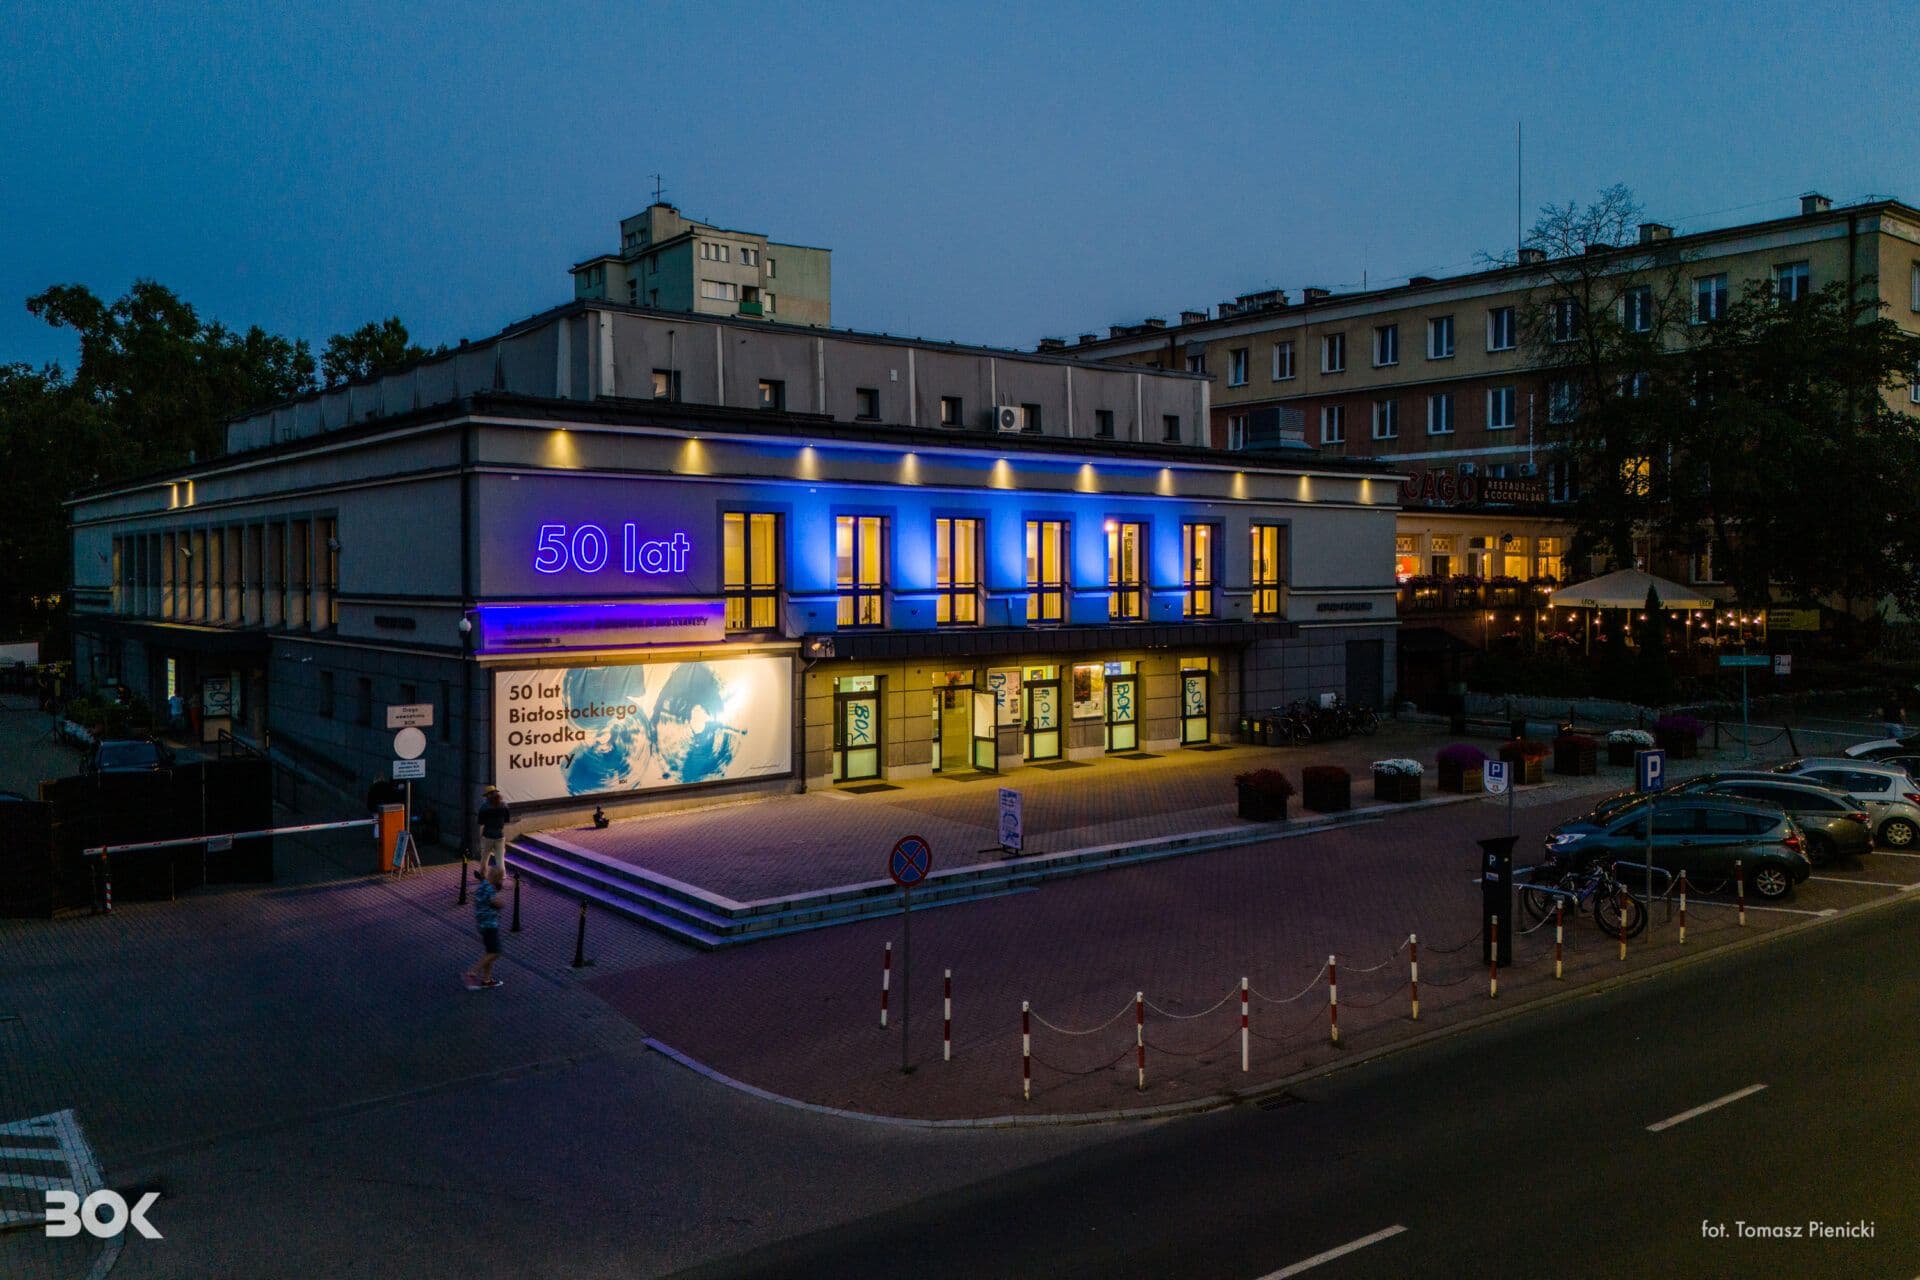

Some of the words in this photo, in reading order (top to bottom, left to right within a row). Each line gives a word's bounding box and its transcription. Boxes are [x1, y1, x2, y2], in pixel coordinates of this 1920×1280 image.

[535, 524, 608, 573] 50
[624, 523, 690, 574] lat
[509, 685, 533, 700] 50
[538, 683, 561, 699] lat
[1117, 684, 1130, 719] BOK
[509, 701, 638, 723] Białostockiego
[854, 704, 870, 743] BOK
[508, 727, 586, 747] Ośrodka
[509, 752, 576, 770] Kultury
[1647, 755, 1661, 787] P
